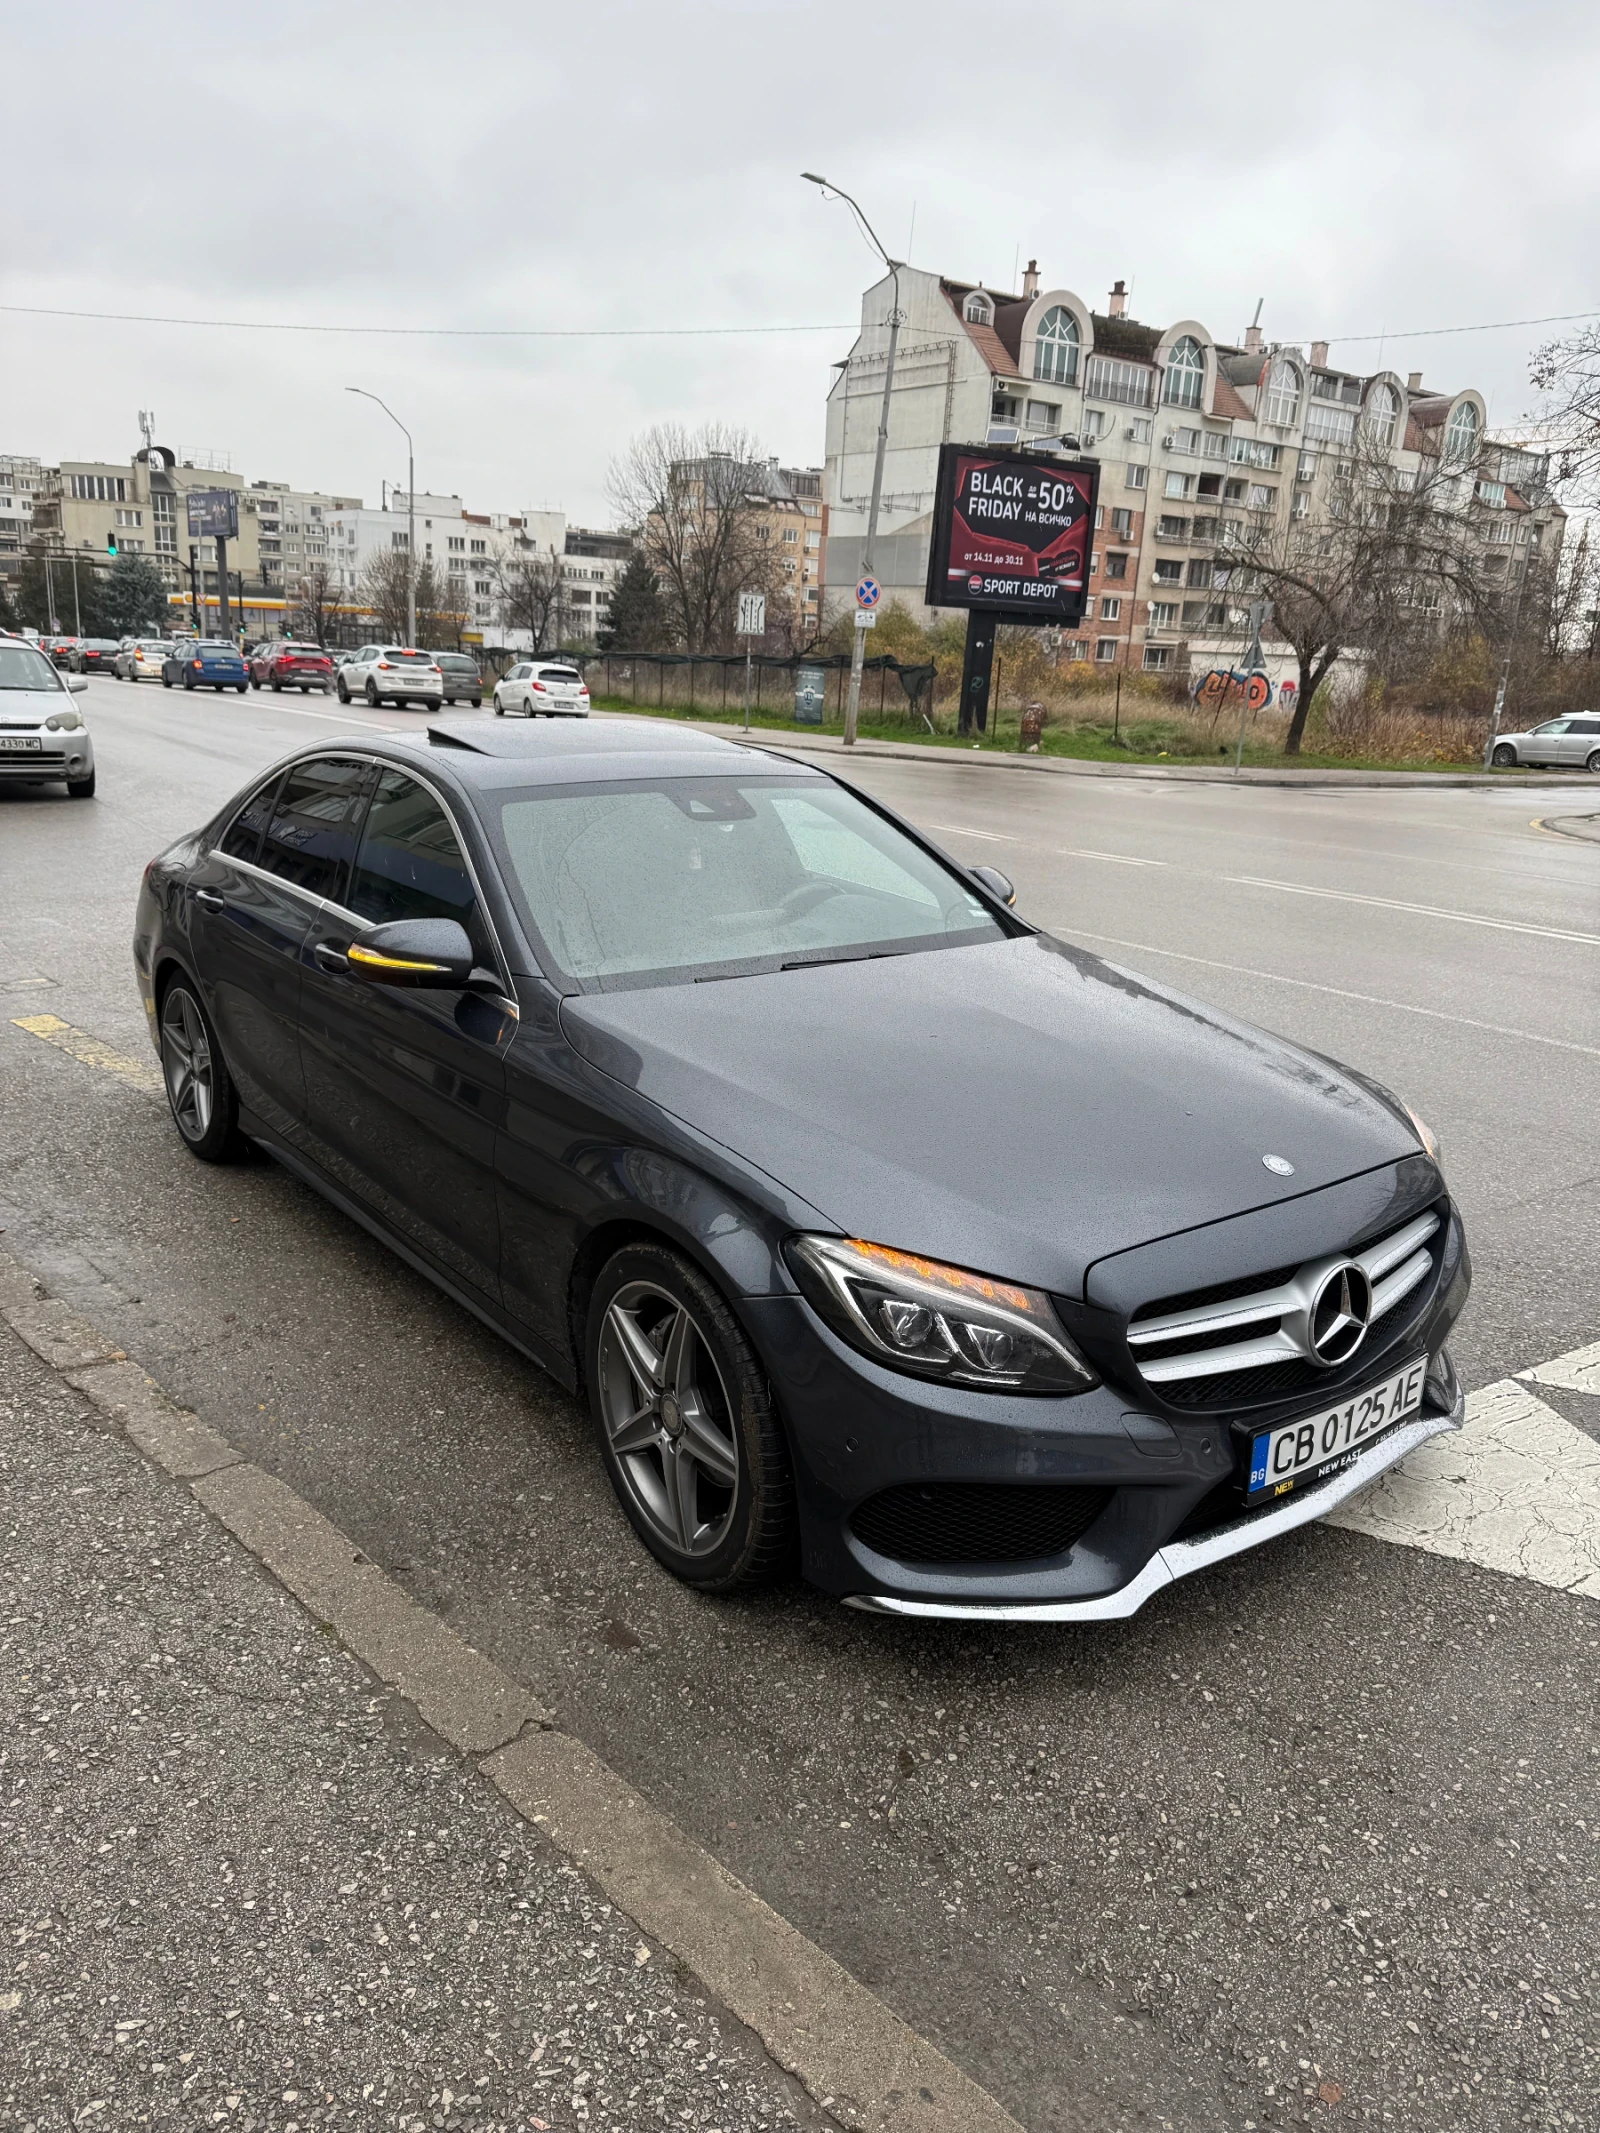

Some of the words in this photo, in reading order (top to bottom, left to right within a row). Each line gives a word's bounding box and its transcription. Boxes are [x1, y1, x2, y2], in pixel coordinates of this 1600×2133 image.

[970, 472, 1024, 497] BLACK
[968, 497, 1023, 520] FRIDAY
[1025, 511, 1037, 522] НА
[1038, 513, 1072, 527] ВСИЧКО
[973, 552, 993, 563] 14.11
[1005, 555, 1024, 565] 30.11
[983, 579, 1020, 595] SPORT
[1022, 582, 1058, 598] DEPOT
[1273, 1423, 1315, 1474] CB
[1321, 1387, 1388, 1454] 0125
[1388, 1366, 1422, 1419] AE
[1318, 1460, 1340, 1477] NEW
[1340, 1448, 1362, 1466] EAST
[1250, 1468, 1265, 1484] BG
[1274, 1479, 1295, 1496] NEW
